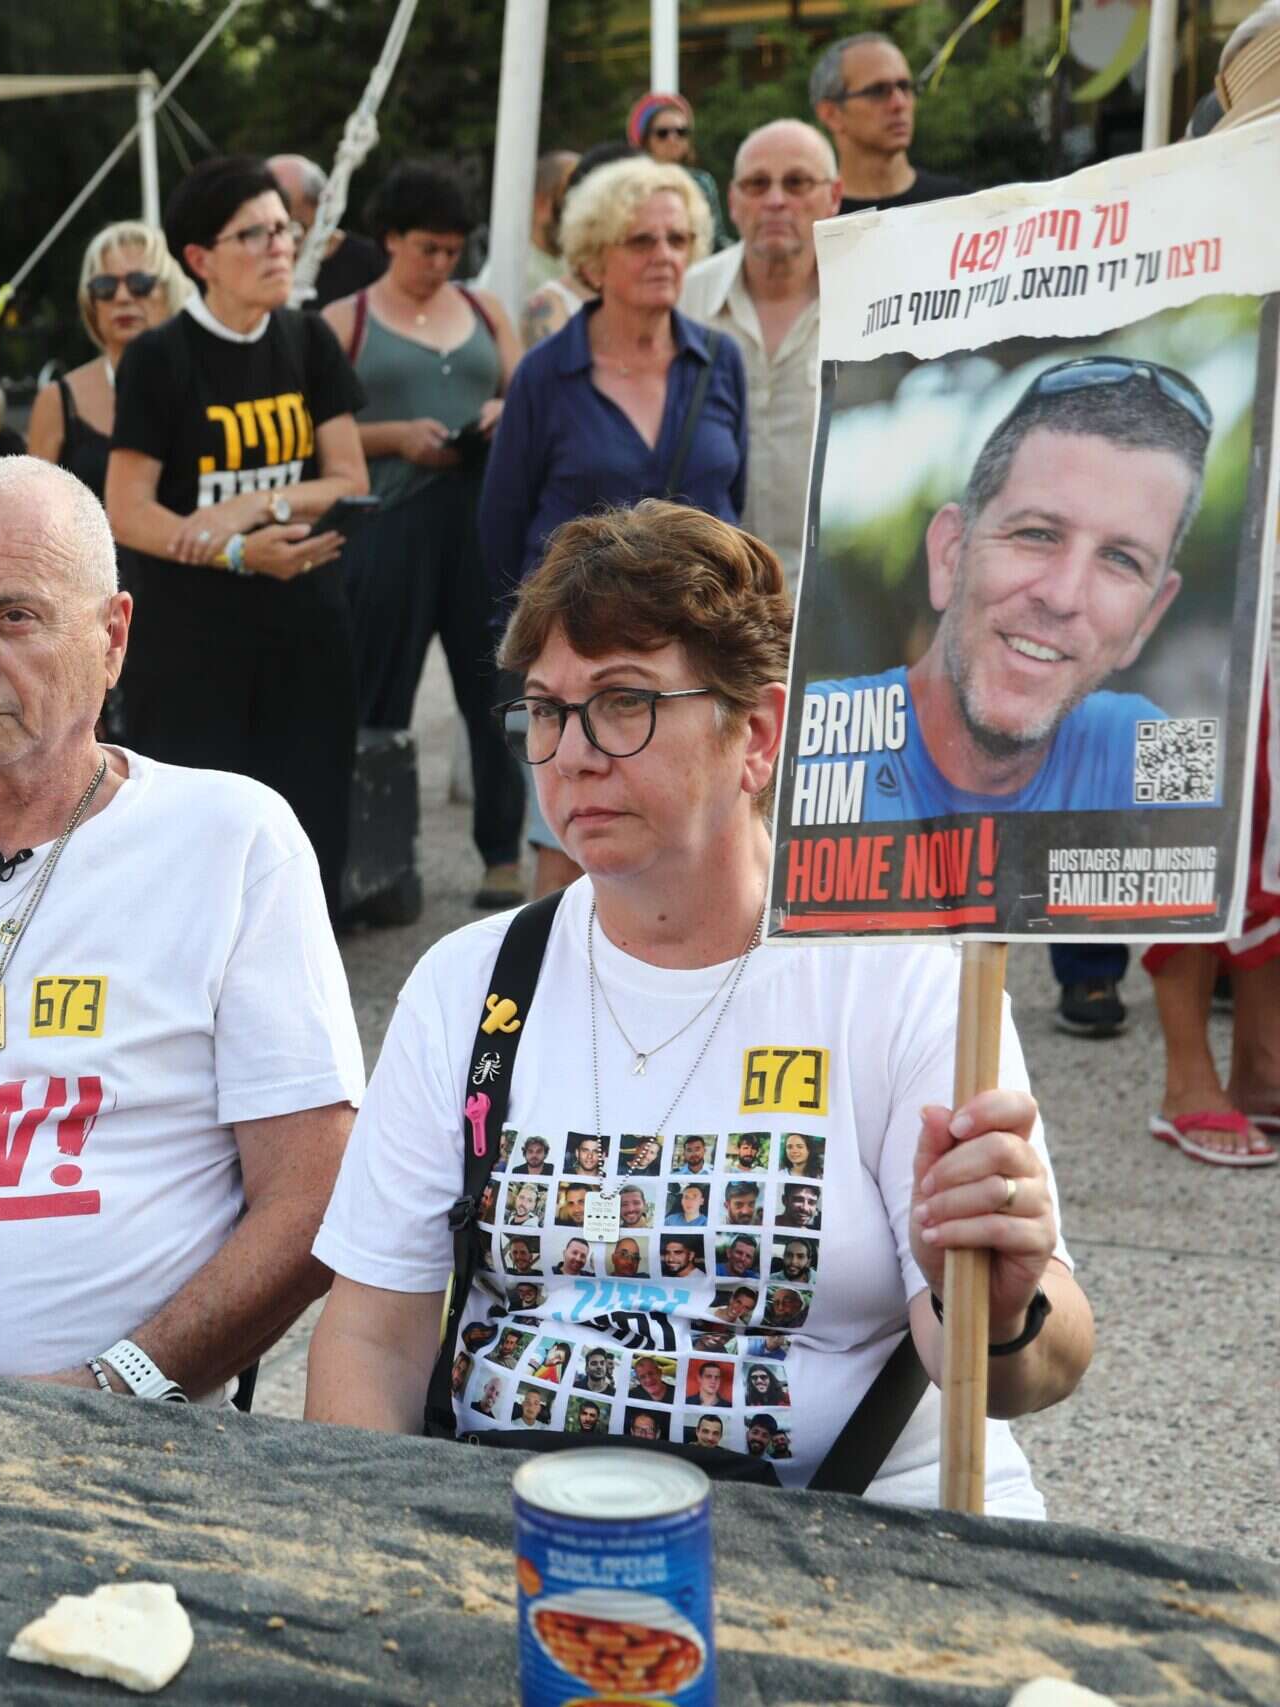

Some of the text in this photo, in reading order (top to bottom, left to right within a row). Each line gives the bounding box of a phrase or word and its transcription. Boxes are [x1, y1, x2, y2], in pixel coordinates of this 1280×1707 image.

[950, 200, 1130, 280] טל חיימי (42)
[861, 237, 1222, 337] נרצח על ידי חמאס. עדיין חטוף בעזה.
[797, 683, 907, 757] BRING
[791, 761, 867, 827] HIM
[786, 817, 999, 903] HOME NOW!
[1048, 845, 1217, 872] HOSTAGES AND MISSING
[1048, 870, 1216, 907] FAMILIES FORUM
[33, 978, 101, 1032] 673
[743, 1049, 824, 1109] 673
